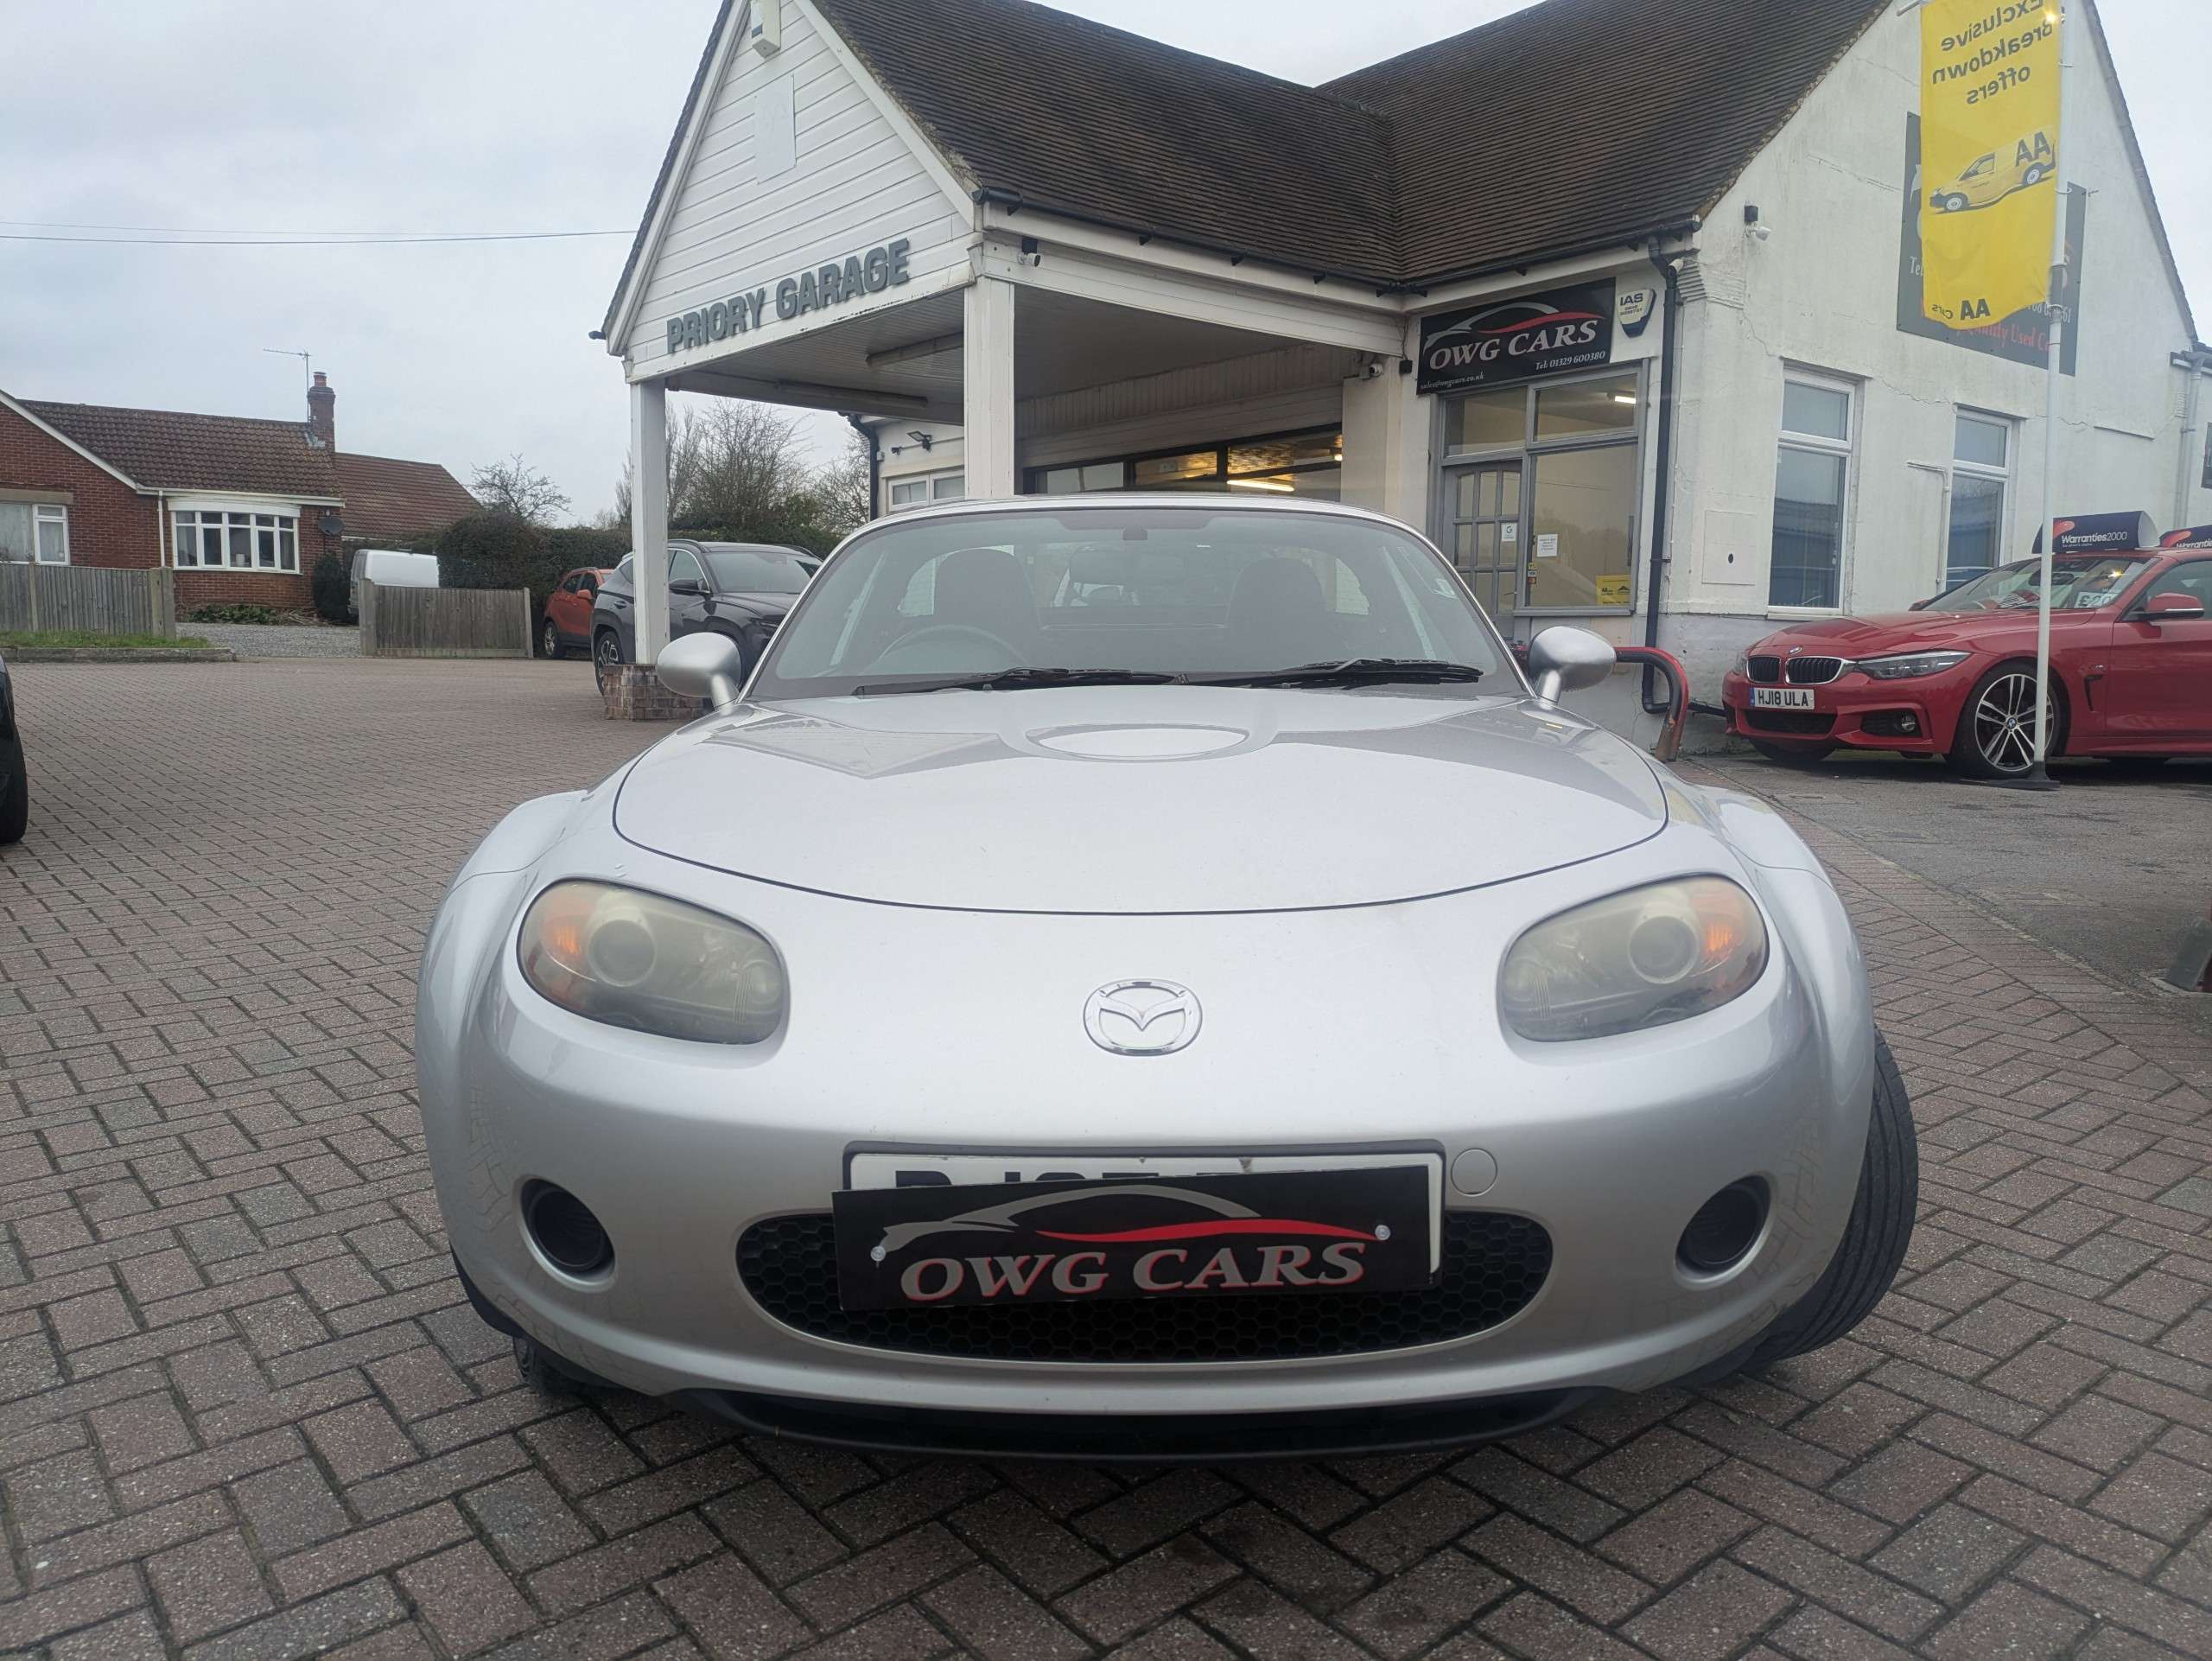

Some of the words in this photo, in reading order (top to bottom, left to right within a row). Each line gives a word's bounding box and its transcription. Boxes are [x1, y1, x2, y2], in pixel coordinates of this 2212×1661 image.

[666, 287, 766, 353] PRIORY
[775, 238, 910, 320] GARAGE
[1620, 293, 1643, 306] IAS
[1429, 338, 1501, 370] OWG
[1508, 320, 1598, 355] CARS
[2011, 323, 2036, 347] Used
[1535, 360, 1548, 371] Tel:
[1549, 357, 1573, 368] 01329
[1573, 351, 1605, 363] 600380
[2061, 531, 2127, 544] Warranties2000
[1758, 690, 1781, 705] HJ18
[1784, 691, 1808, 706] ULA
[900, 1251, 1109, 1301] OWG
[1134, 1242, 1366, 1290] CARS
